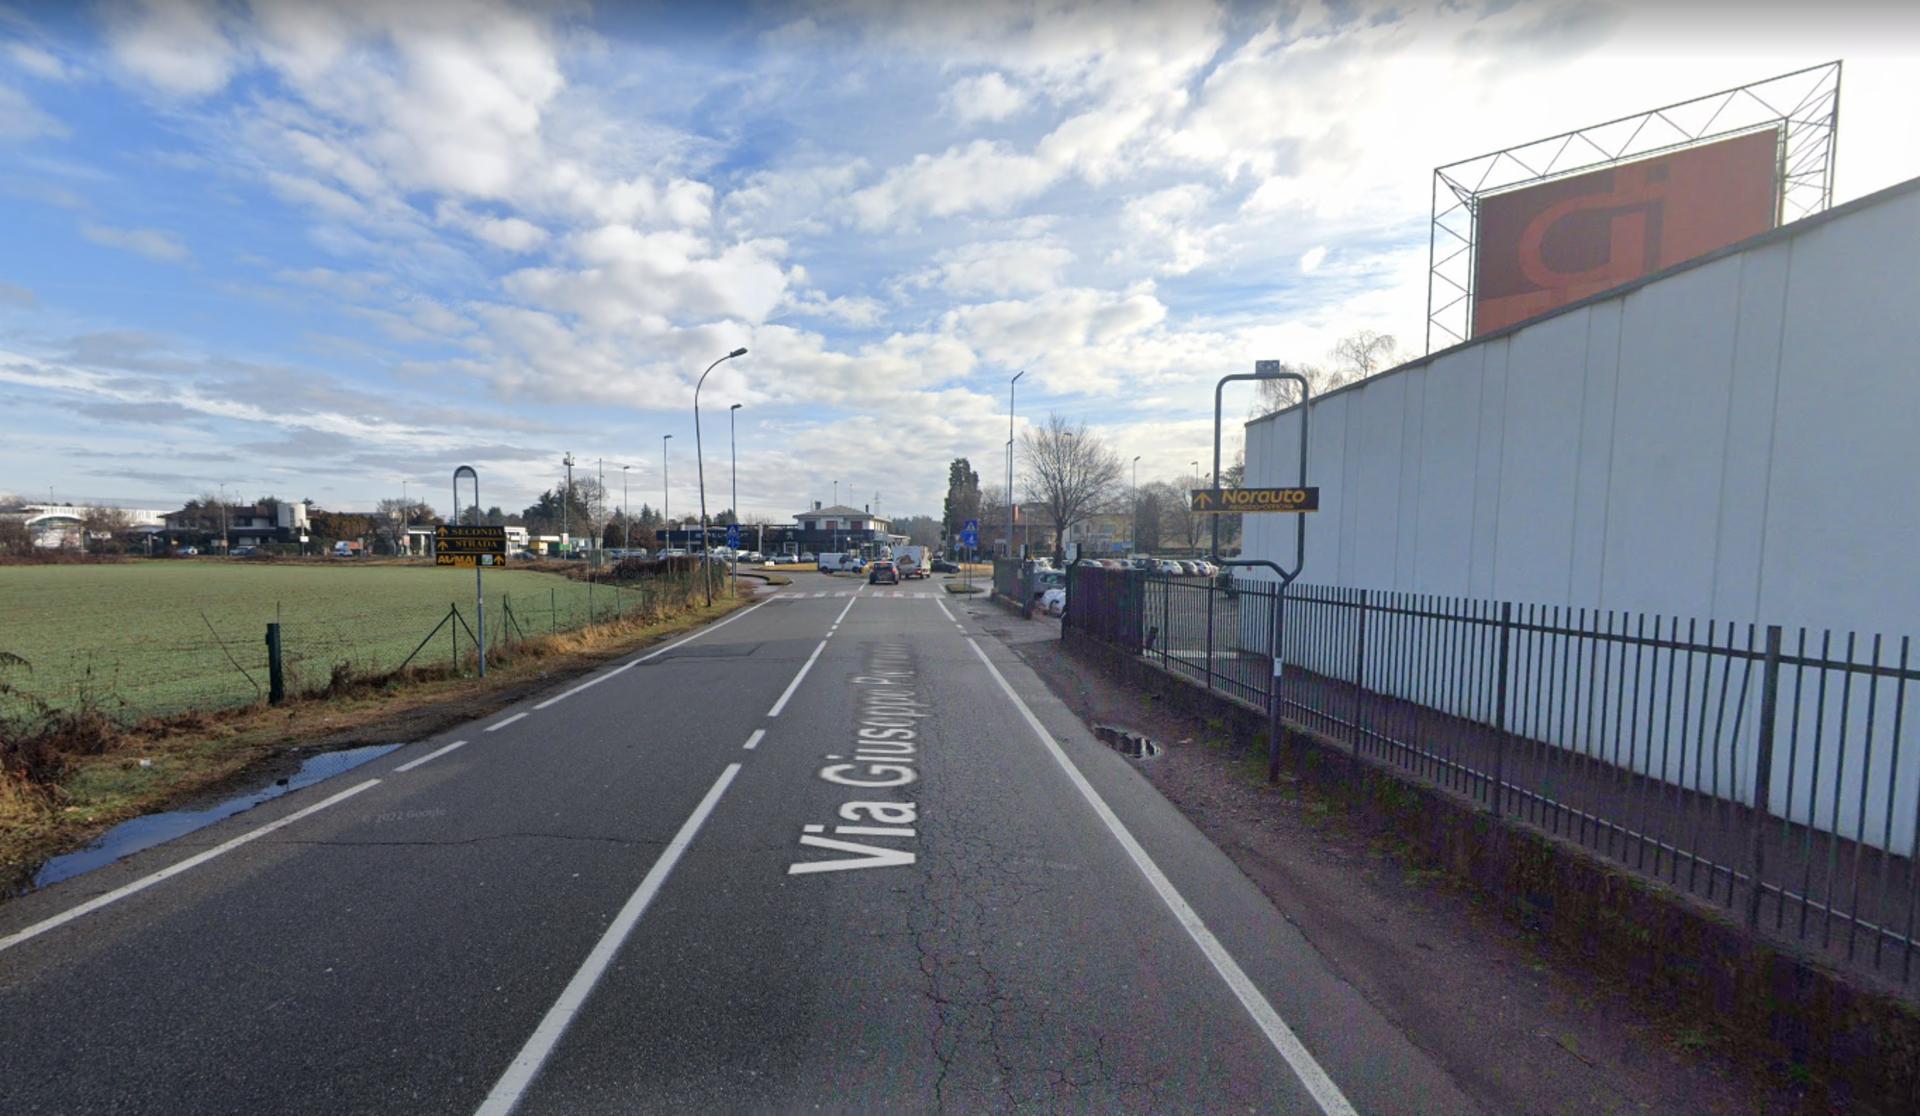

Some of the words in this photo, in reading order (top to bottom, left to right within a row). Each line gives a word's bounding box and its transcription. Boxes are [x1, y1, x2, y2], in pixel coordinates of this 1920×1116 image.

[1221, 489, 1306, 504] Norauto
[451, 528, 503, 536] SECONDA
[455, 540, 497, 548] STRADA
